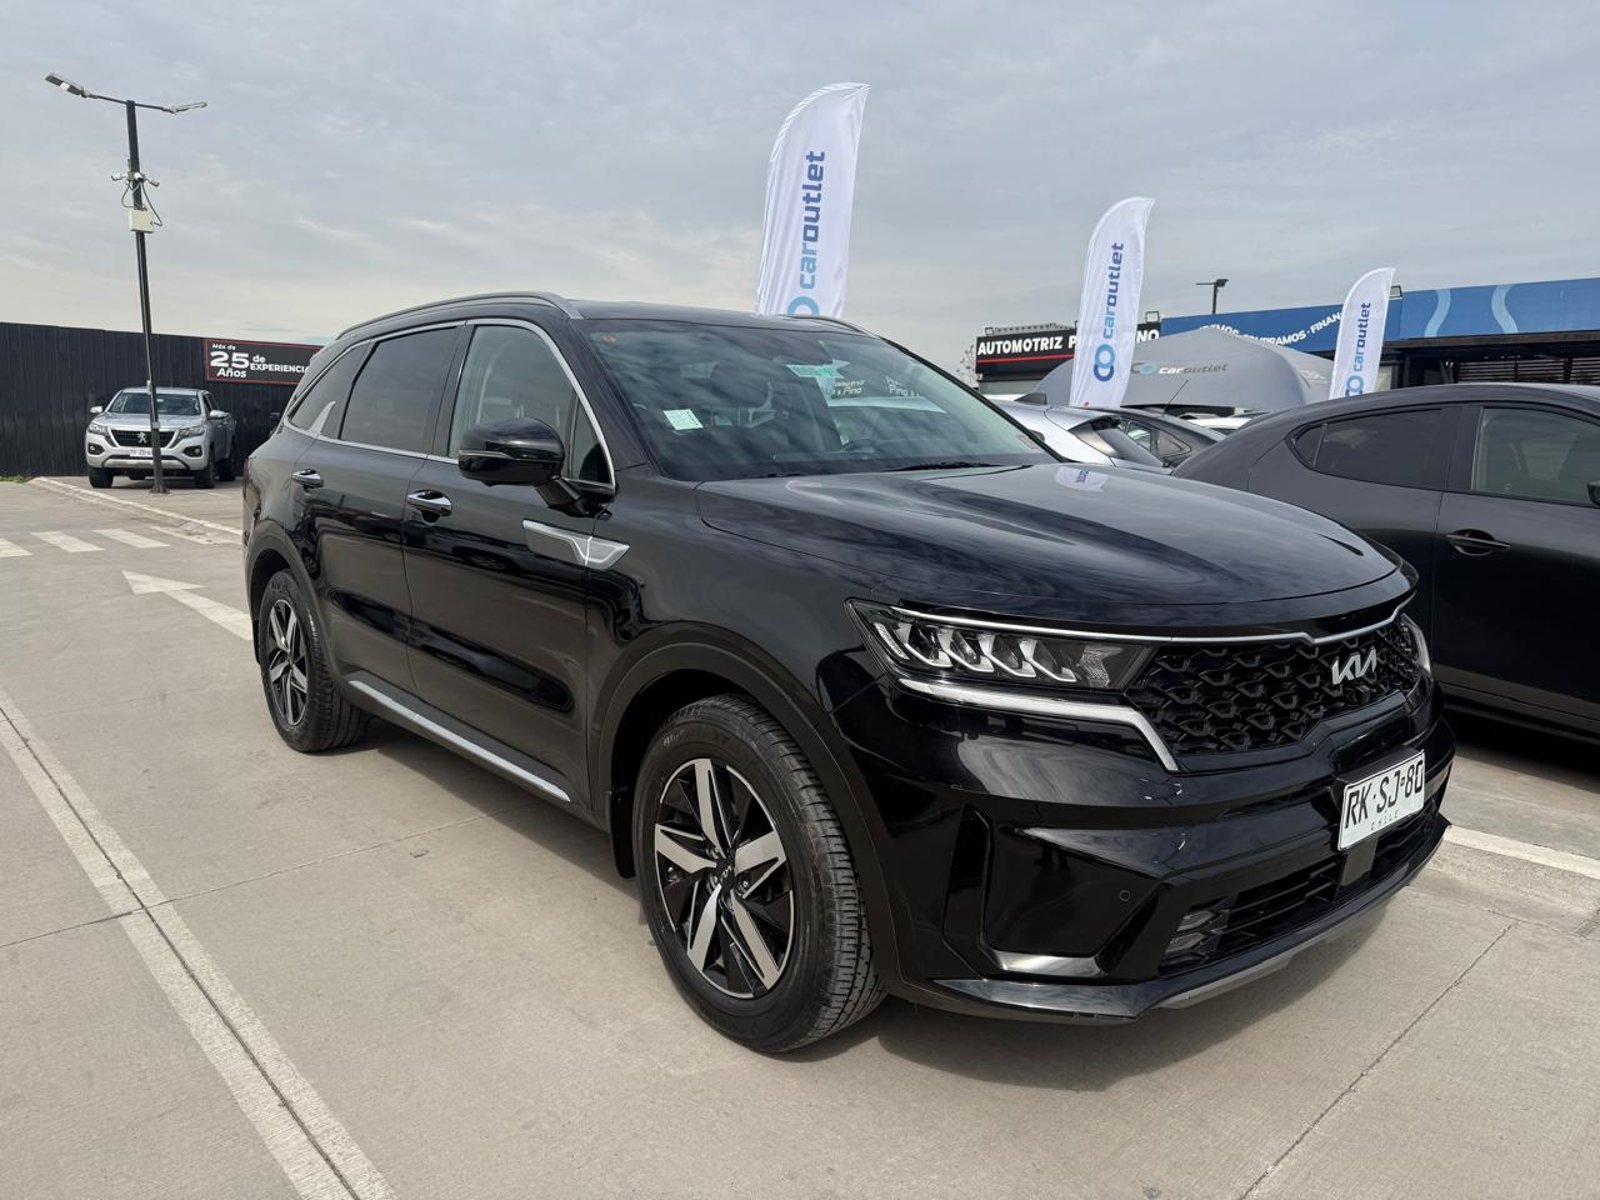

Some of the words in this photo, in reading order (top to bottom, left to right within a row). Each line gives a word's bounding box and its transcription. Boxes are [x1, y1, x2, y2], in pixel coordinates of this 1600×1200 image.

[800, 150, 825, 290] caroutlet
[1103, 242, 1124, 339] caroutlet
[977, 336, 1063, 356] AUTOMOTRIZ
[1353, 302, 1371, 372] caroutlet
[210, 350, 250, 369] 25
[252, 354, 266, 363] de
[216, 367, 247, 378] Años
[1158, 363, 1228, 375] caroutlet
